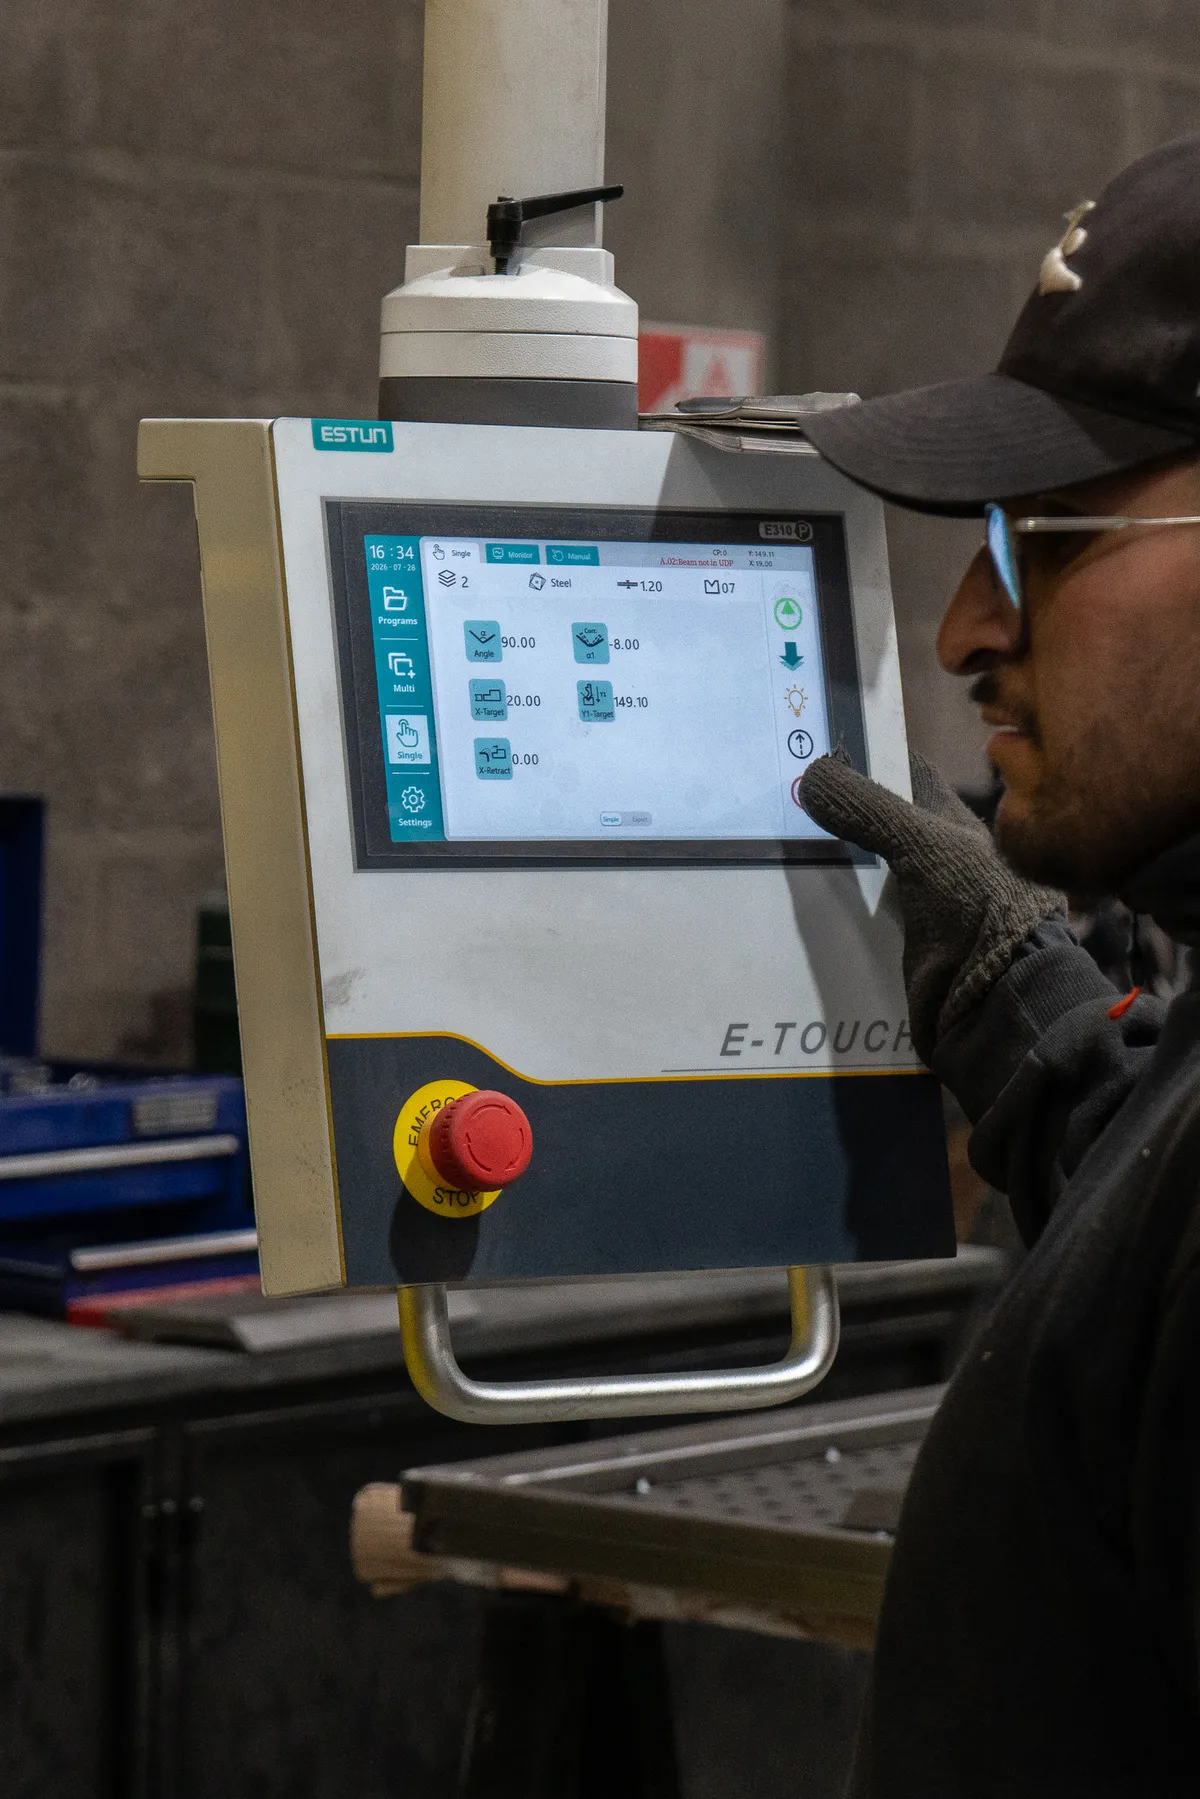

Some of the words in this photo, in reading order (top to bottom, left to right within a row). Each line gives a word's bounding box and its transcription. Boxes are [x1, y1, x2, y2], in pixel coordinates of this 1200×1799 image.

[320, 426, 387, 444] ESTUN
[764, 524, 793, 536] E310
[451, 549, 472, 558] Single
[508, 551, 533, 560] Monitor
[567, 552, 591, 561] Manual
[461, 576, 469, 588] 2
[550, 578, 572, 588] Steel
[639, 581, 663, 592] 1.20
[721, 582, 735, 593] 07
[378, 616, 418, 627] Programs
[501, 636, 536, 649] 90.00
[608, 639, 640, 650] -8.00
[474, 650, 495, 659] Angle
[393, 684, 416, 693] Multi
[506, 695, 541, 707] 20.00
[614, 697, 648, 708] 149.10
[475, 707, 505, 717] X-Target
[581, 710, 615, 719] Y1-Target
[397, 751, 423, 762] Single
[512, 754, 539, 766] 0.00
[478, 766, 511, 776] X-Retract
[398, 818, 432, 829] Settings
[720, 1019, 914, 1056] E-TOUCH
